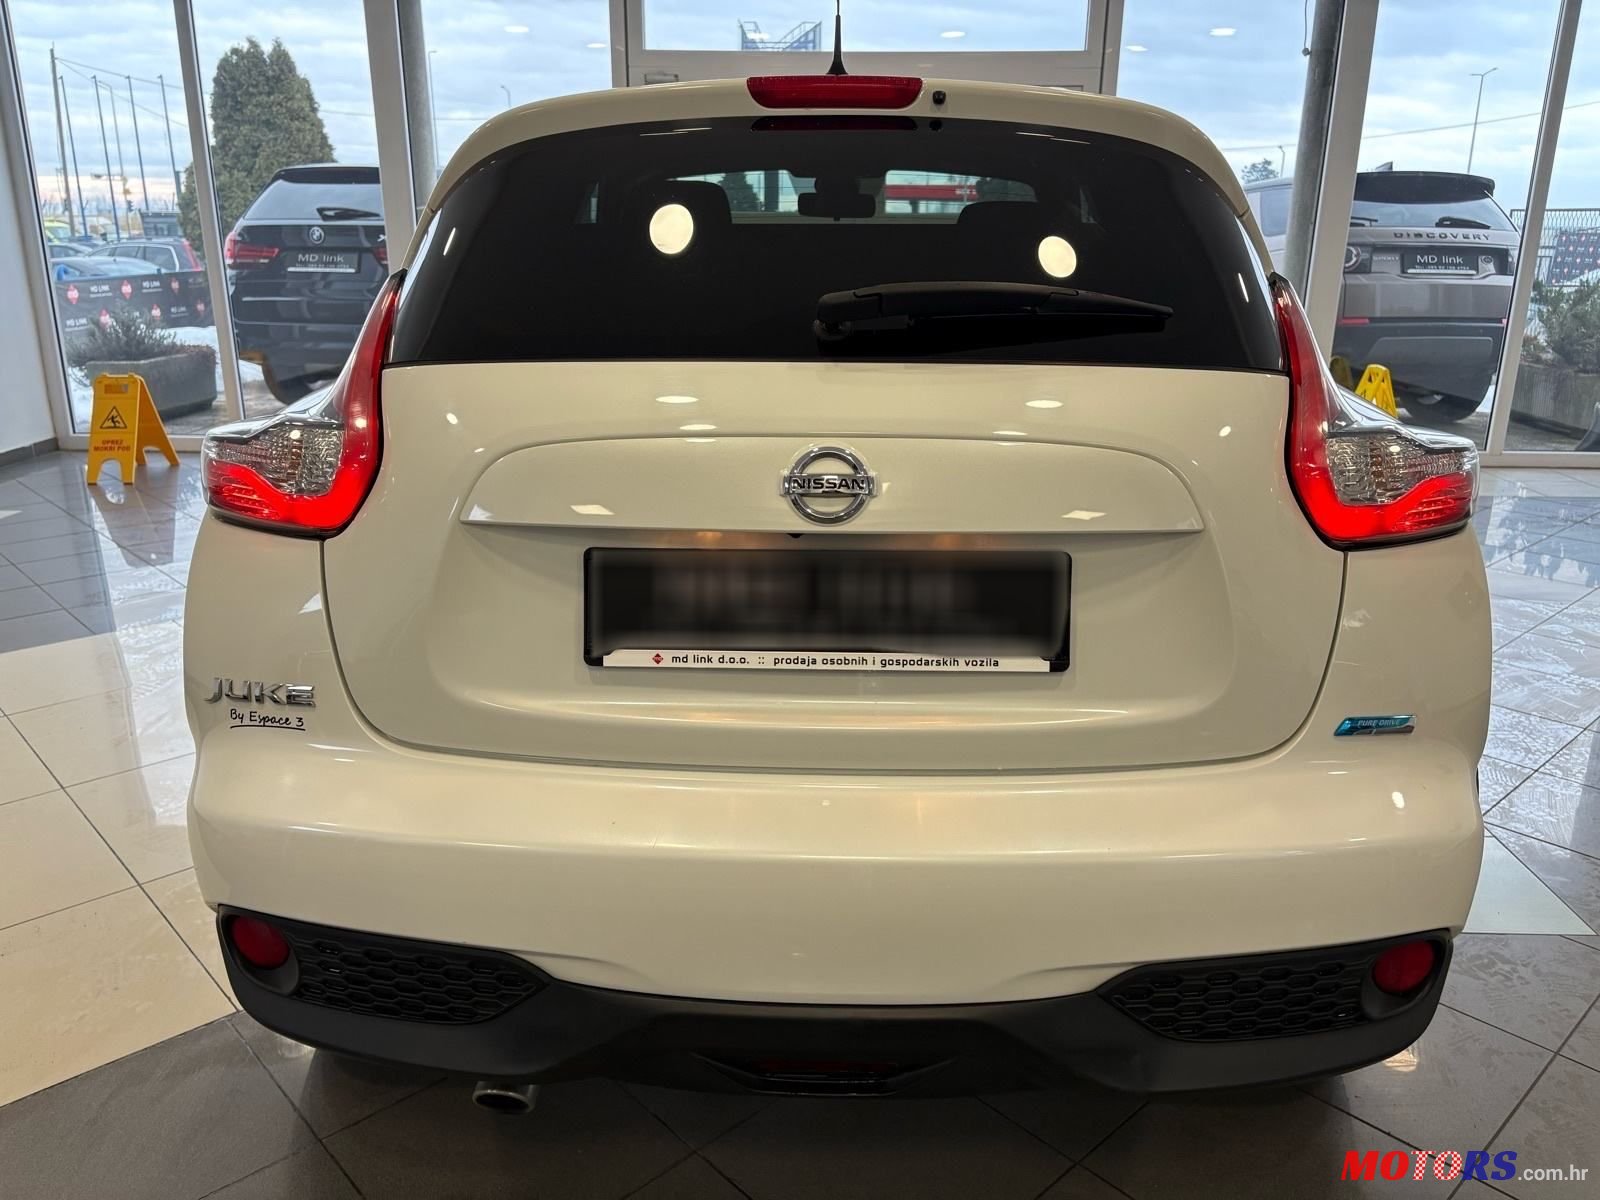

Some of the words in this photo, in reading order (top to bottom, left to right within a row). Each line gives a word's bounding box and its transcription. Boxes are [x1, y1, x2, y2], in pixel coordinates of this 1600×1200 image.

[1393, 232, 1490, 241] DISCOVERY
[297, 254, 319, 262] MD
[323, 254, 344, 263] link
[1416, 254, 1438, 264] MD
[1442, 255, 1464, 264] link
[790, 477, 866, 491] NISSAN
[671, 654, 689, 664] md
[693, 654, 713, 664] link
[718, 654, 750, 665] d.o.o.
[773, 655, 817, 667] prodaja
[821, 656, 868, 667] osobnih
[880, 657, 960, 668] gospodarskih
[964, 659, 999, 668] vozila
[204, 677, 316, 707] JUKE
[230, 708, 244, 724] By
[249, 711, 291, 727] Espace
[296, 717, 304, 727] 3
[1357, 719, 1377, 728] PURE
